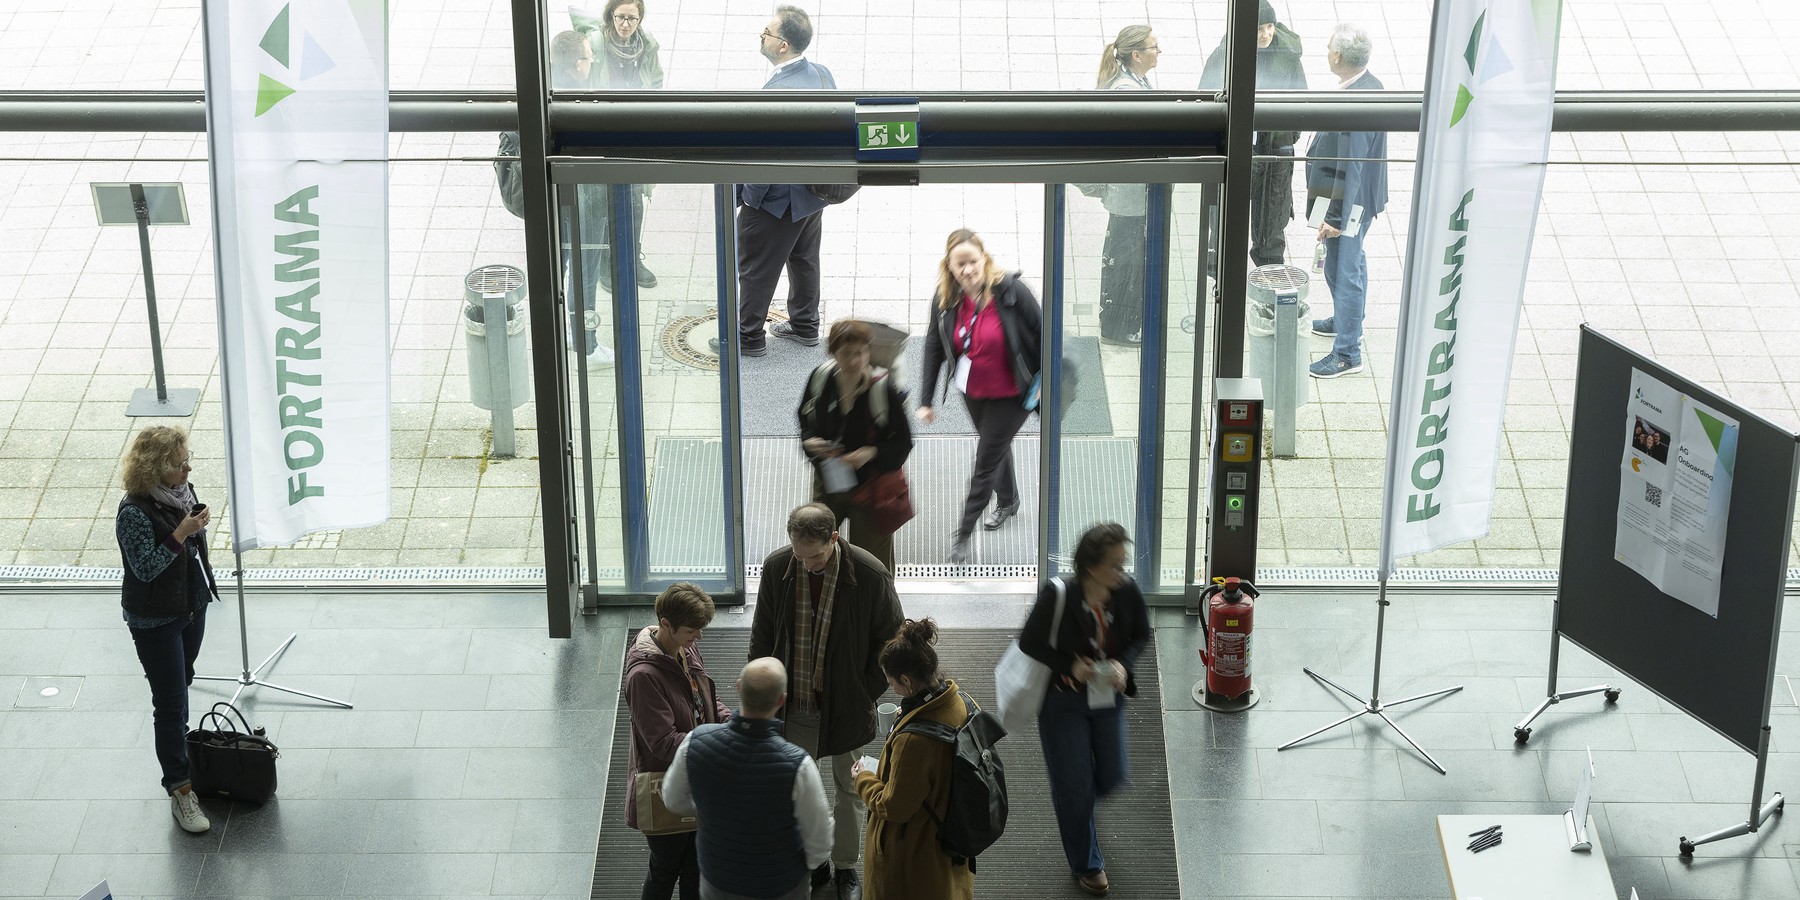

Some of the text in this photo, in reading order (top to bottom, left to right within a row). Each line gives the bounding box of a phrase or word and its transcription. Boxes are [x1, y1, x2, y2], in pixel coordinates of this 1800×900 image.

[274, 184, 325, 507] FORTRAMA
[1406, 188, 1475, 523] FORTRAMA
[1640, 399, 1662, 414] FORTRAMA
[1679, 445, 1689, 456] AG
[1678, 455, 1714, 482] Onboarding
